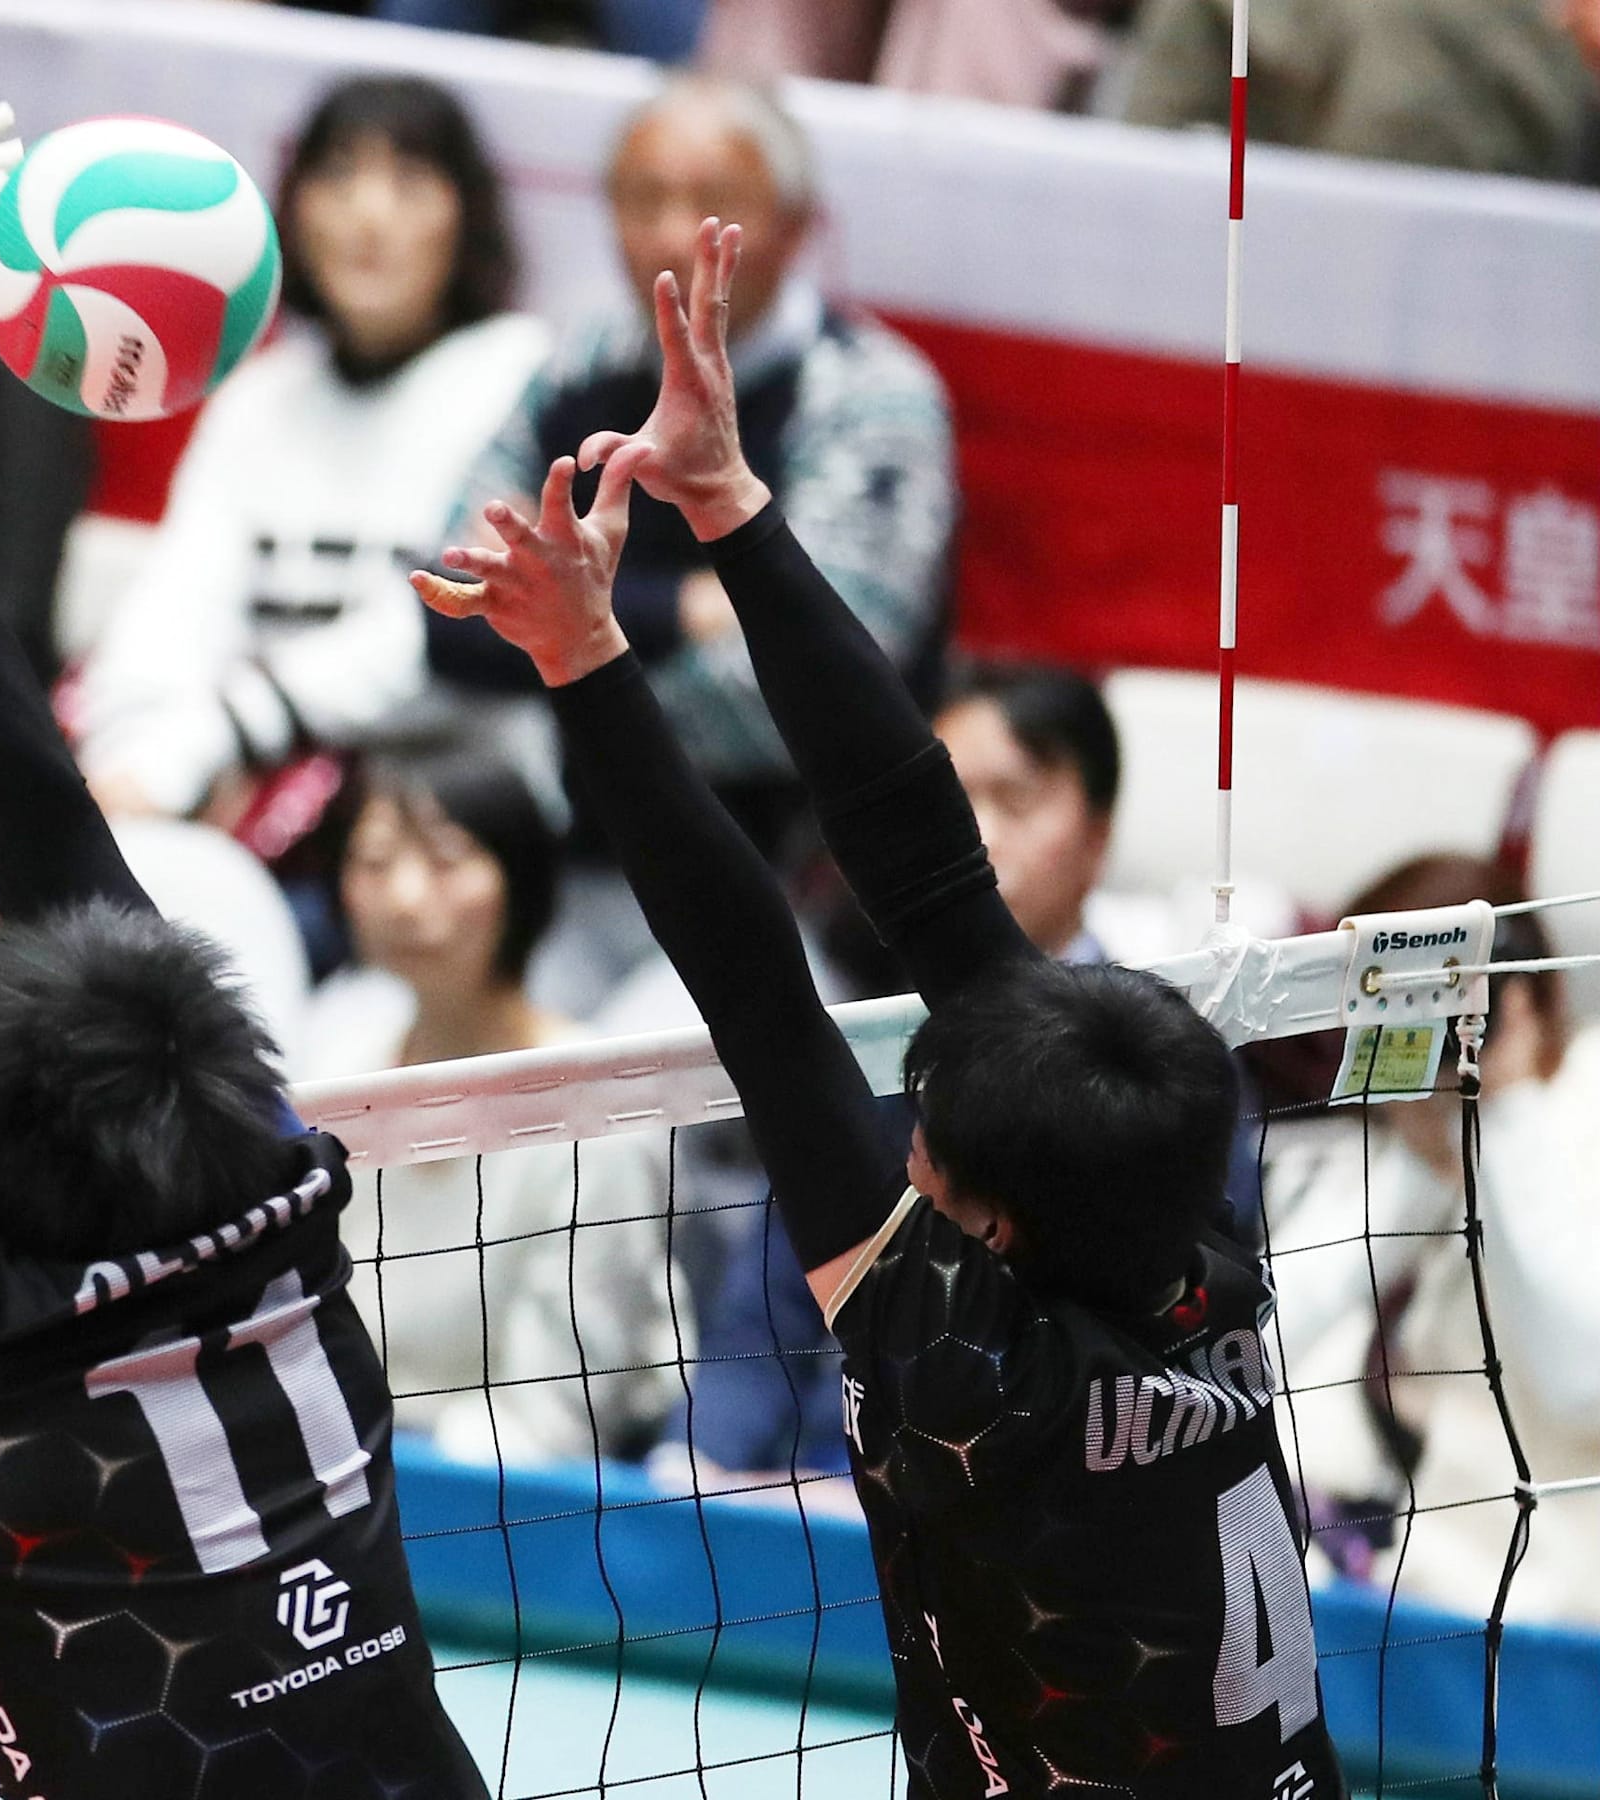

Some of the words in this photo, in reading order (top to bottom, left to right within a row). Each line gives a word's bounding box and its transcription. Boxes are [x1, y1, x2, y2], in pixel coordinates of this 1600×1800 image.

[1389, 926, 1468, 950] Senoh
[84, 1268, 372, 1574] 11
[230, 1655, 343, 1709] TOYODA
[344, 1614, 407, 1666] GOSEI
[1212, 1462, 1319, 1745] 4
